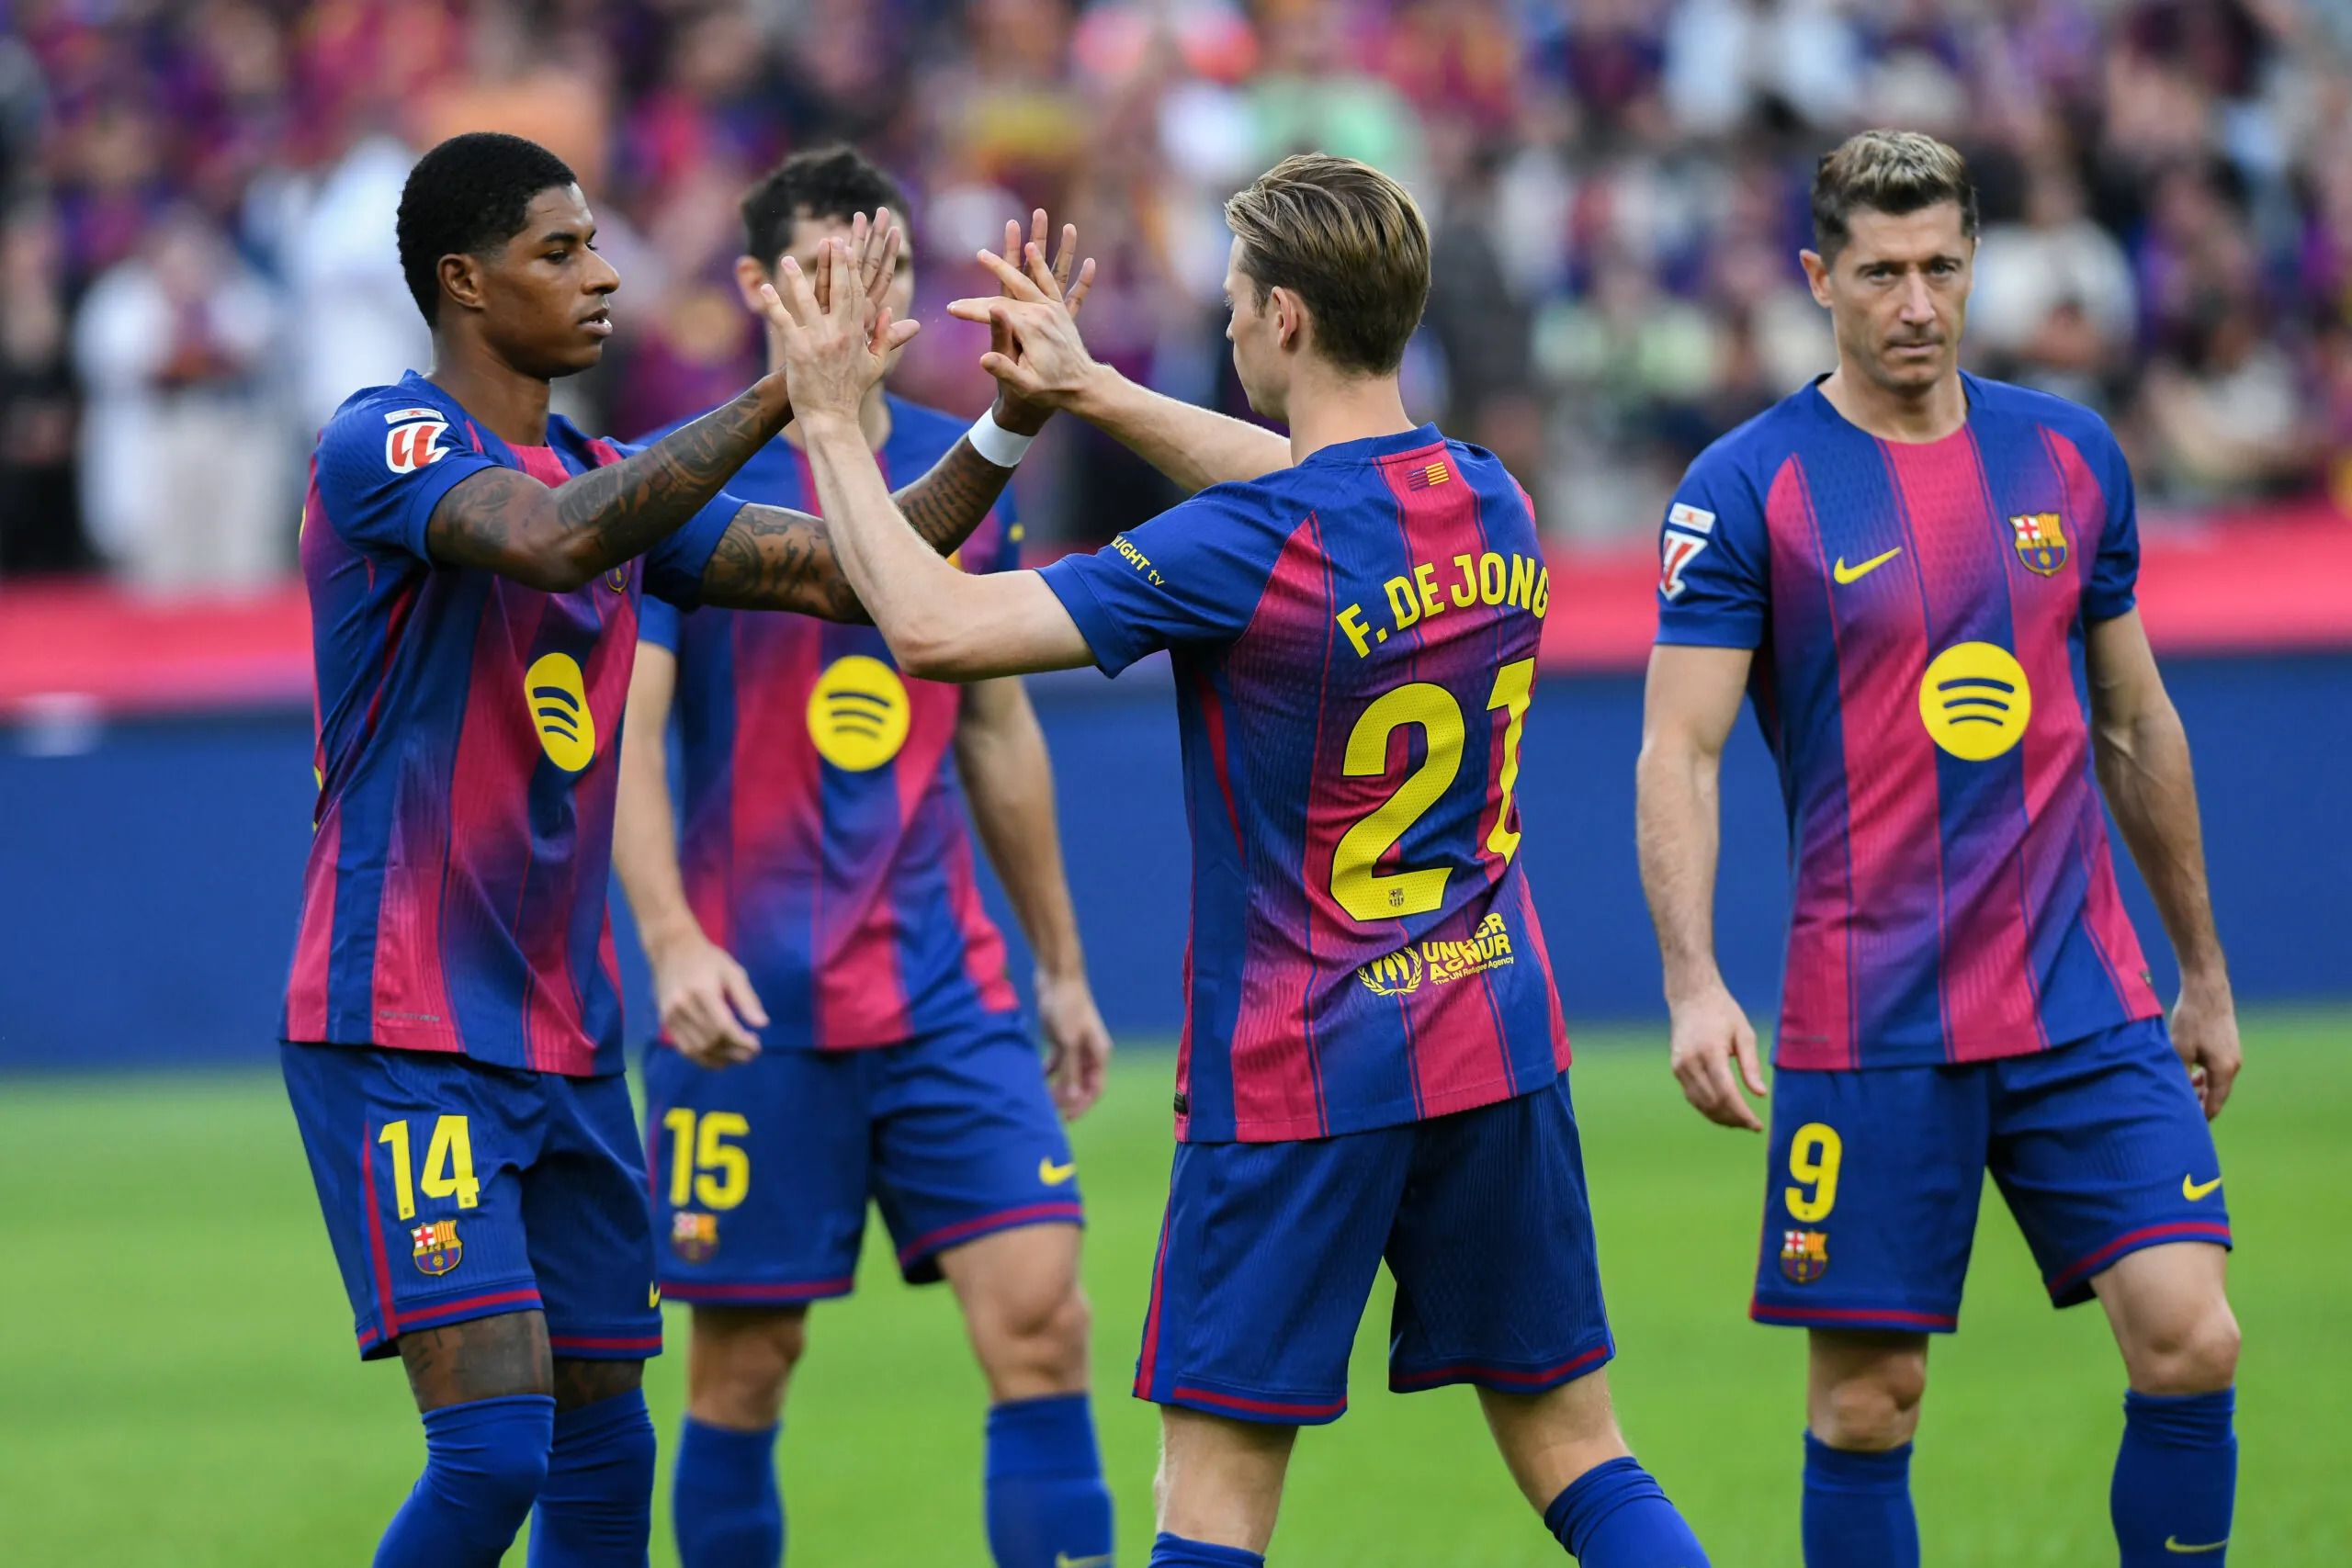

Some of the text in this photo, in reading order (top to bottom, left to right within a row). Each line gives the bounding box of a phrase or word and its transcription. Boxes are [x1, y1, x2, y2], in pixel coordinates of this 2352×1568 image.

[1148, 570, 1165, 586] tv
[1336, 552, 1549, 659] F. DE JONG
[1330, 657, 1535, 922] 21
[1449, 970, 1463, 980] UN
[1487, 956, 1514, 968] Agency
[378, 1114, 481, 1221] 14
[663, 1107, 751, 1211] 15
[1784, 1122, 1843, 1224] 9
